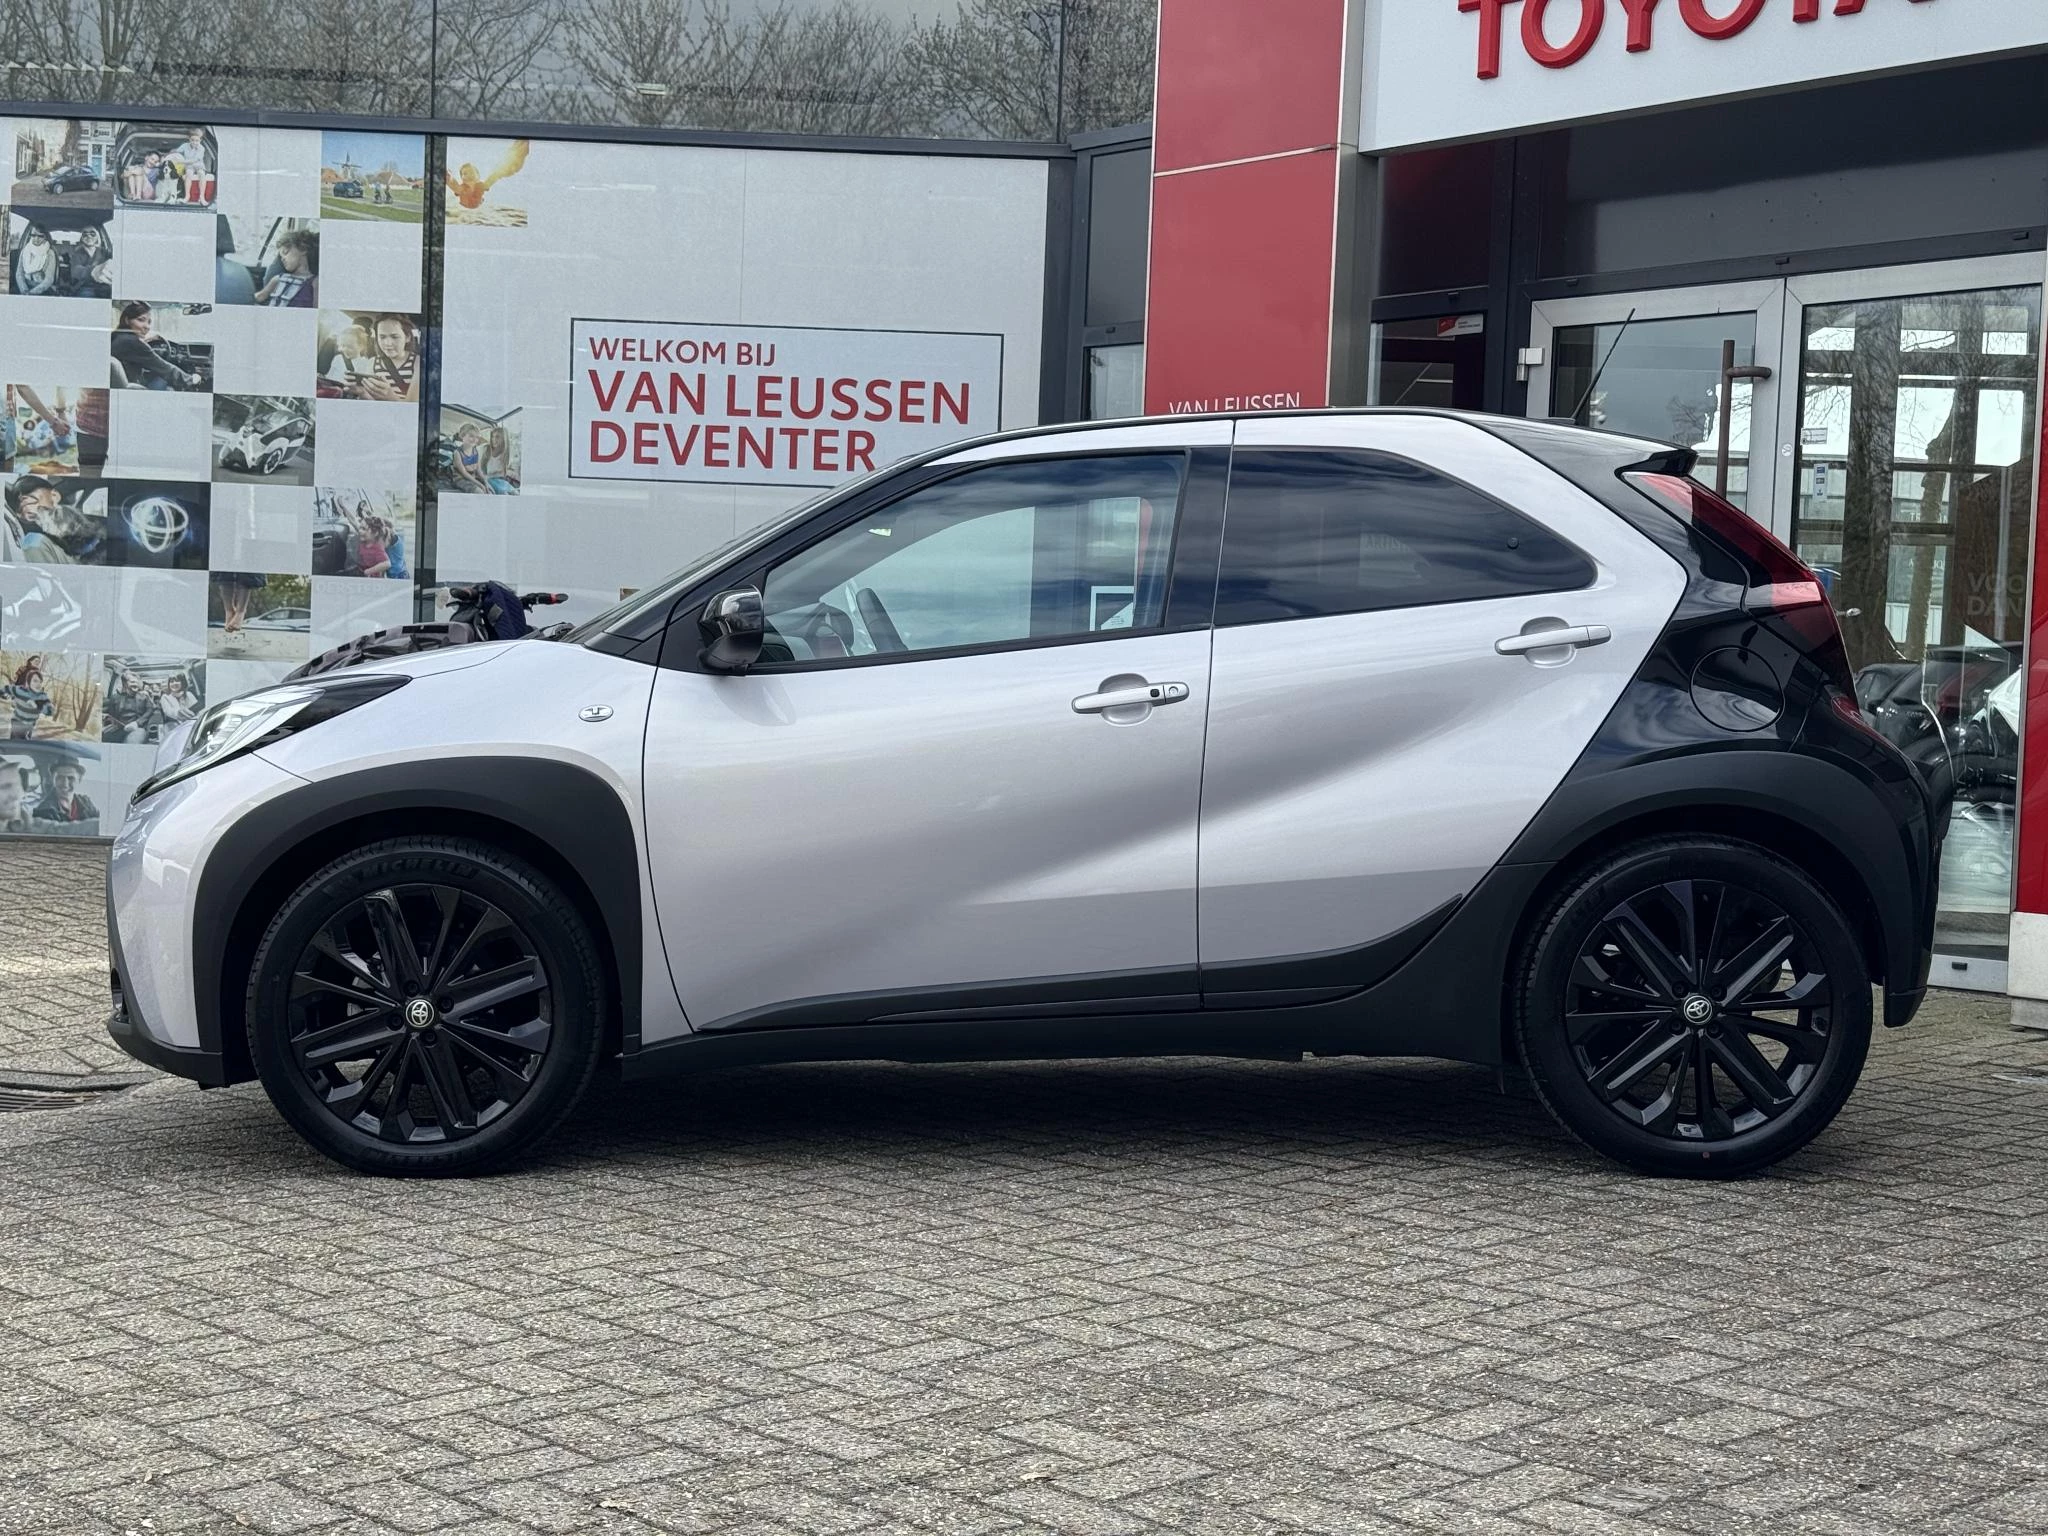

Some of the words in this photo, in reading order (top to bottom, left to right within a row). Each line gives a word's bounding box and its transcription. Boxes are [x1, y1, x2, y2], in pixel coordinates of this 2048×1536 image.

[1458, 0, 1934, 79] TOY
[588, 336, 726, 365] WELKOM
[736, 342, 776, 367] BIJ
[588, 369, 705, 415] VAN
[726, 374, 970, 425] LEUSSEN
[1169, 400, 1208, 414] VAN
[590, 421, 876, 472] DEVENTER
